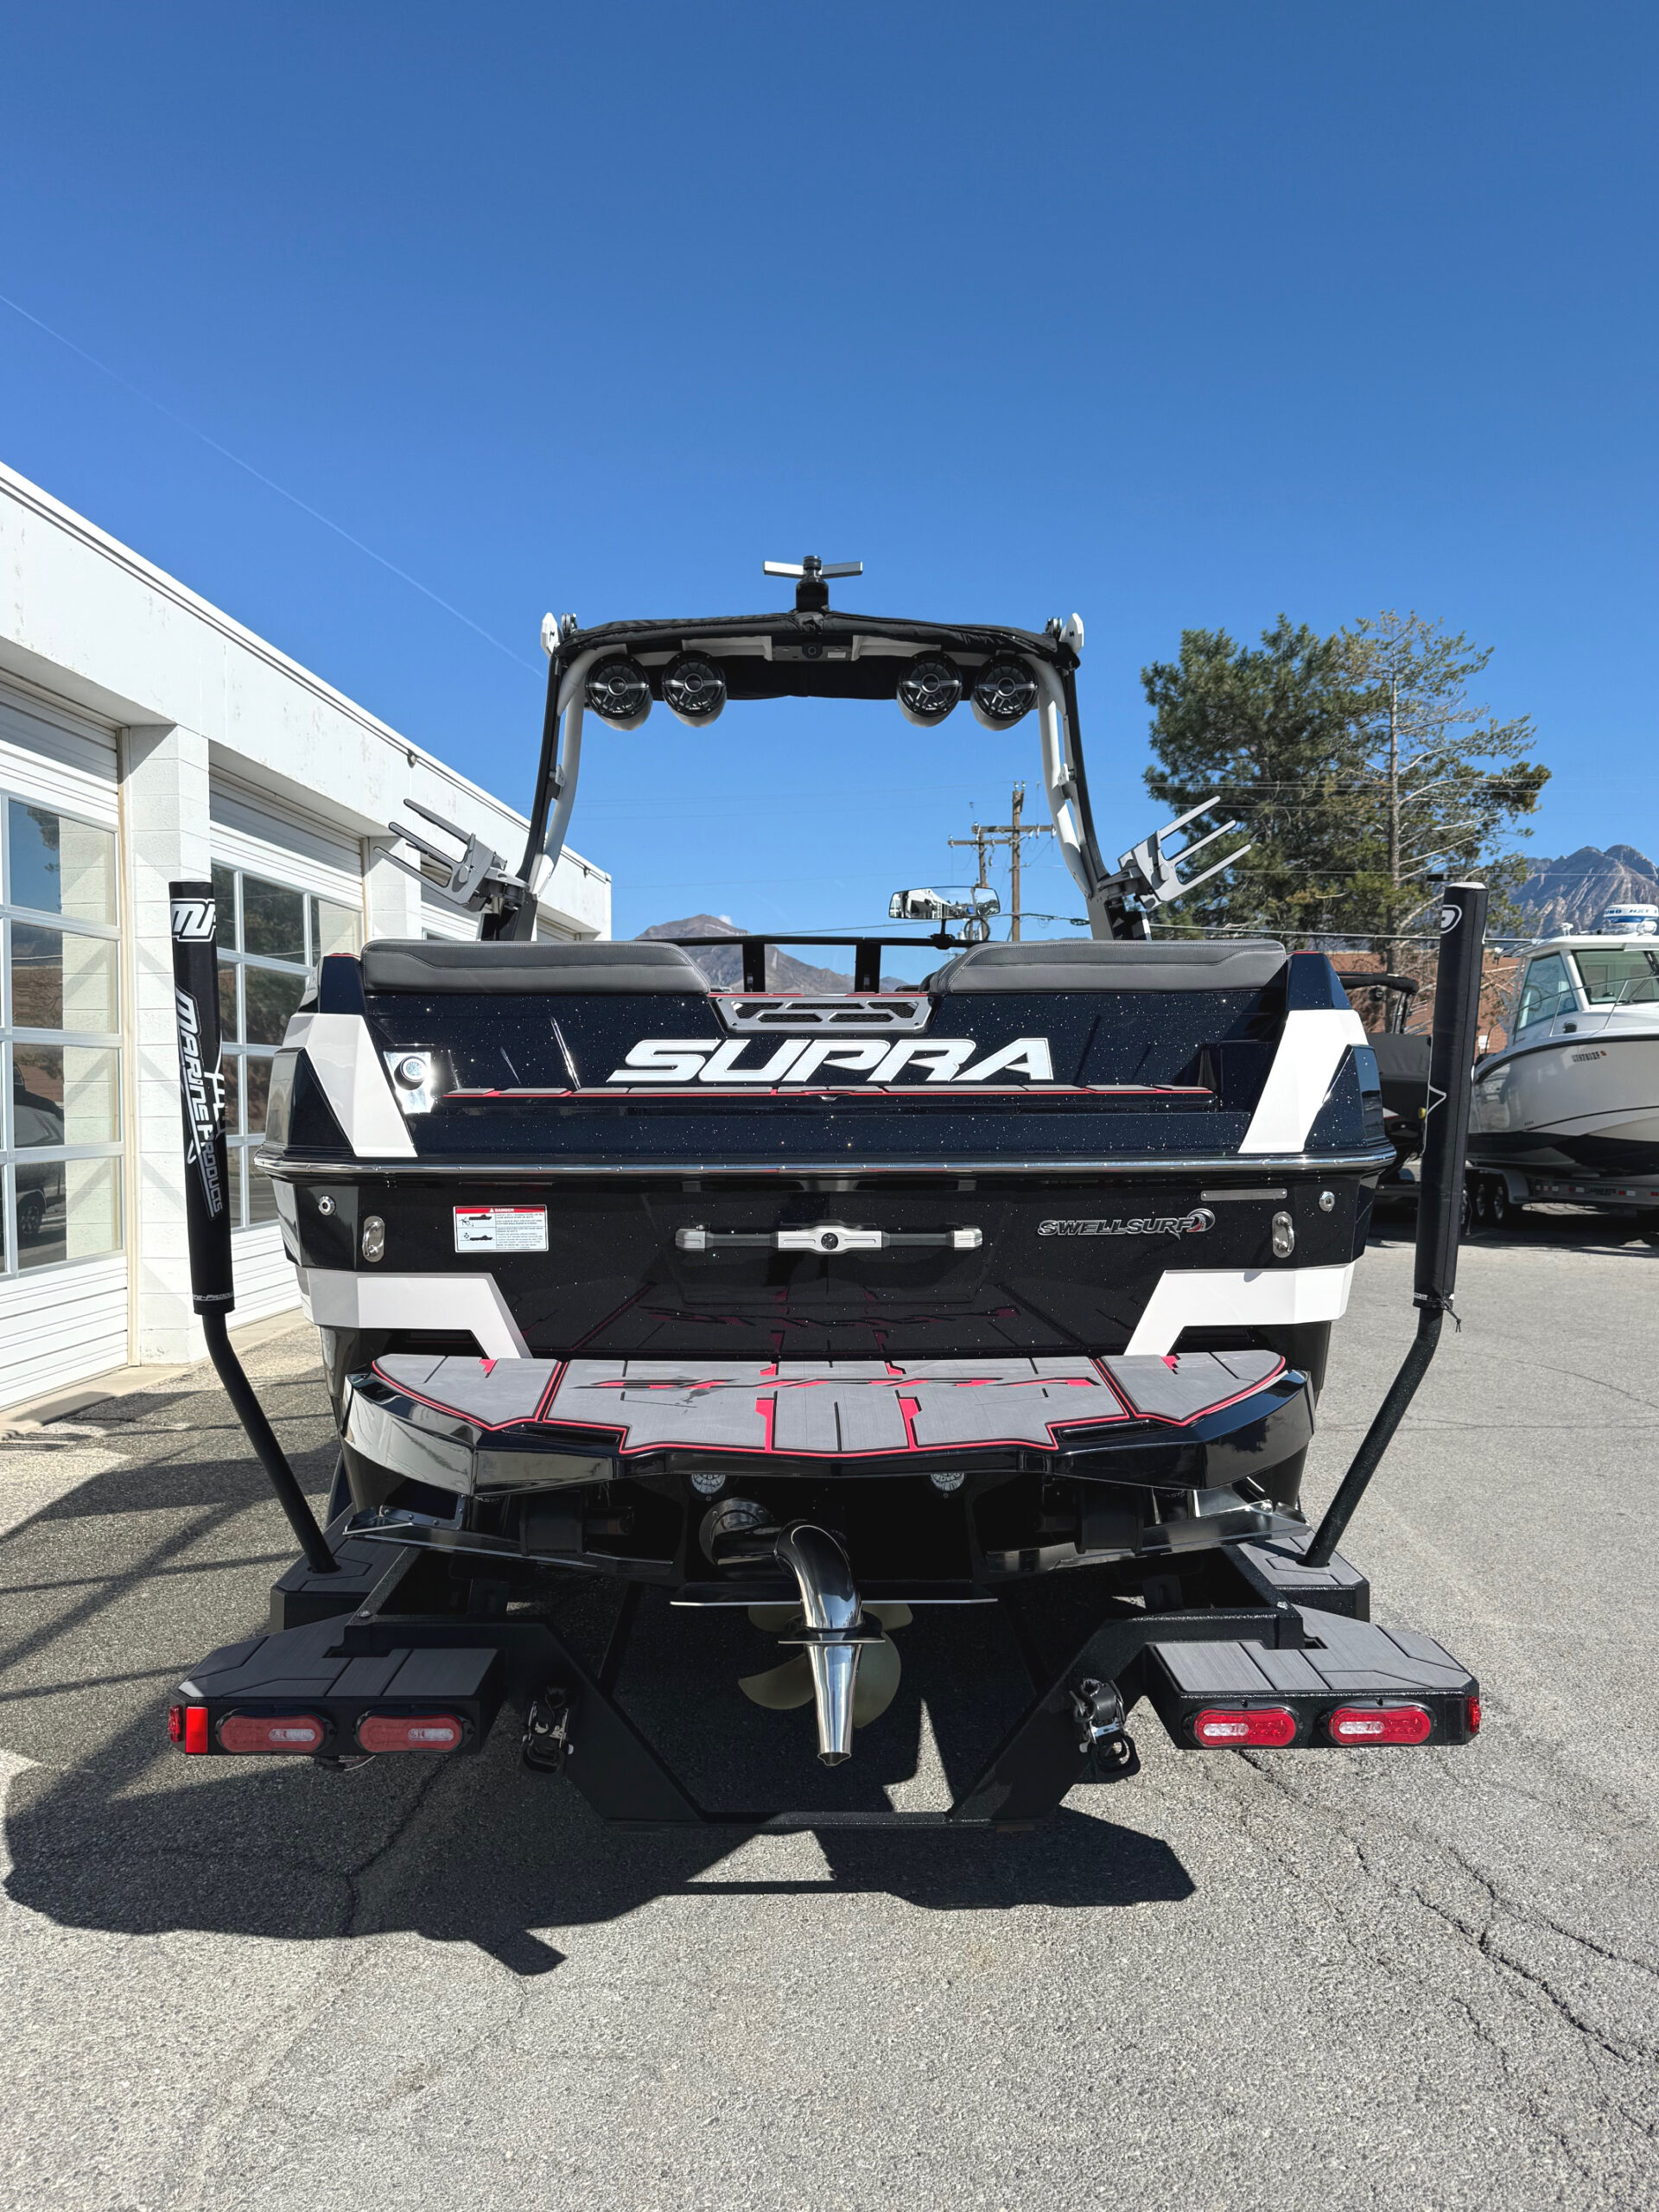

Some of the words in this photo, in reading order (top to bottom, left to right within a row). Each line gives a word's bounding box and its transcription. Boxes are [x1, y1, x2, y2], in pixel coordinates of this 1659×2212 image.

[606, 1038, 1054, 1083] SUPRA
[175, 986, 209, 1122] MARINE
[196, 1122, 224, 1213] PRODUCTS
[1038, 1217, 1198, 1240] SWELLSURF
